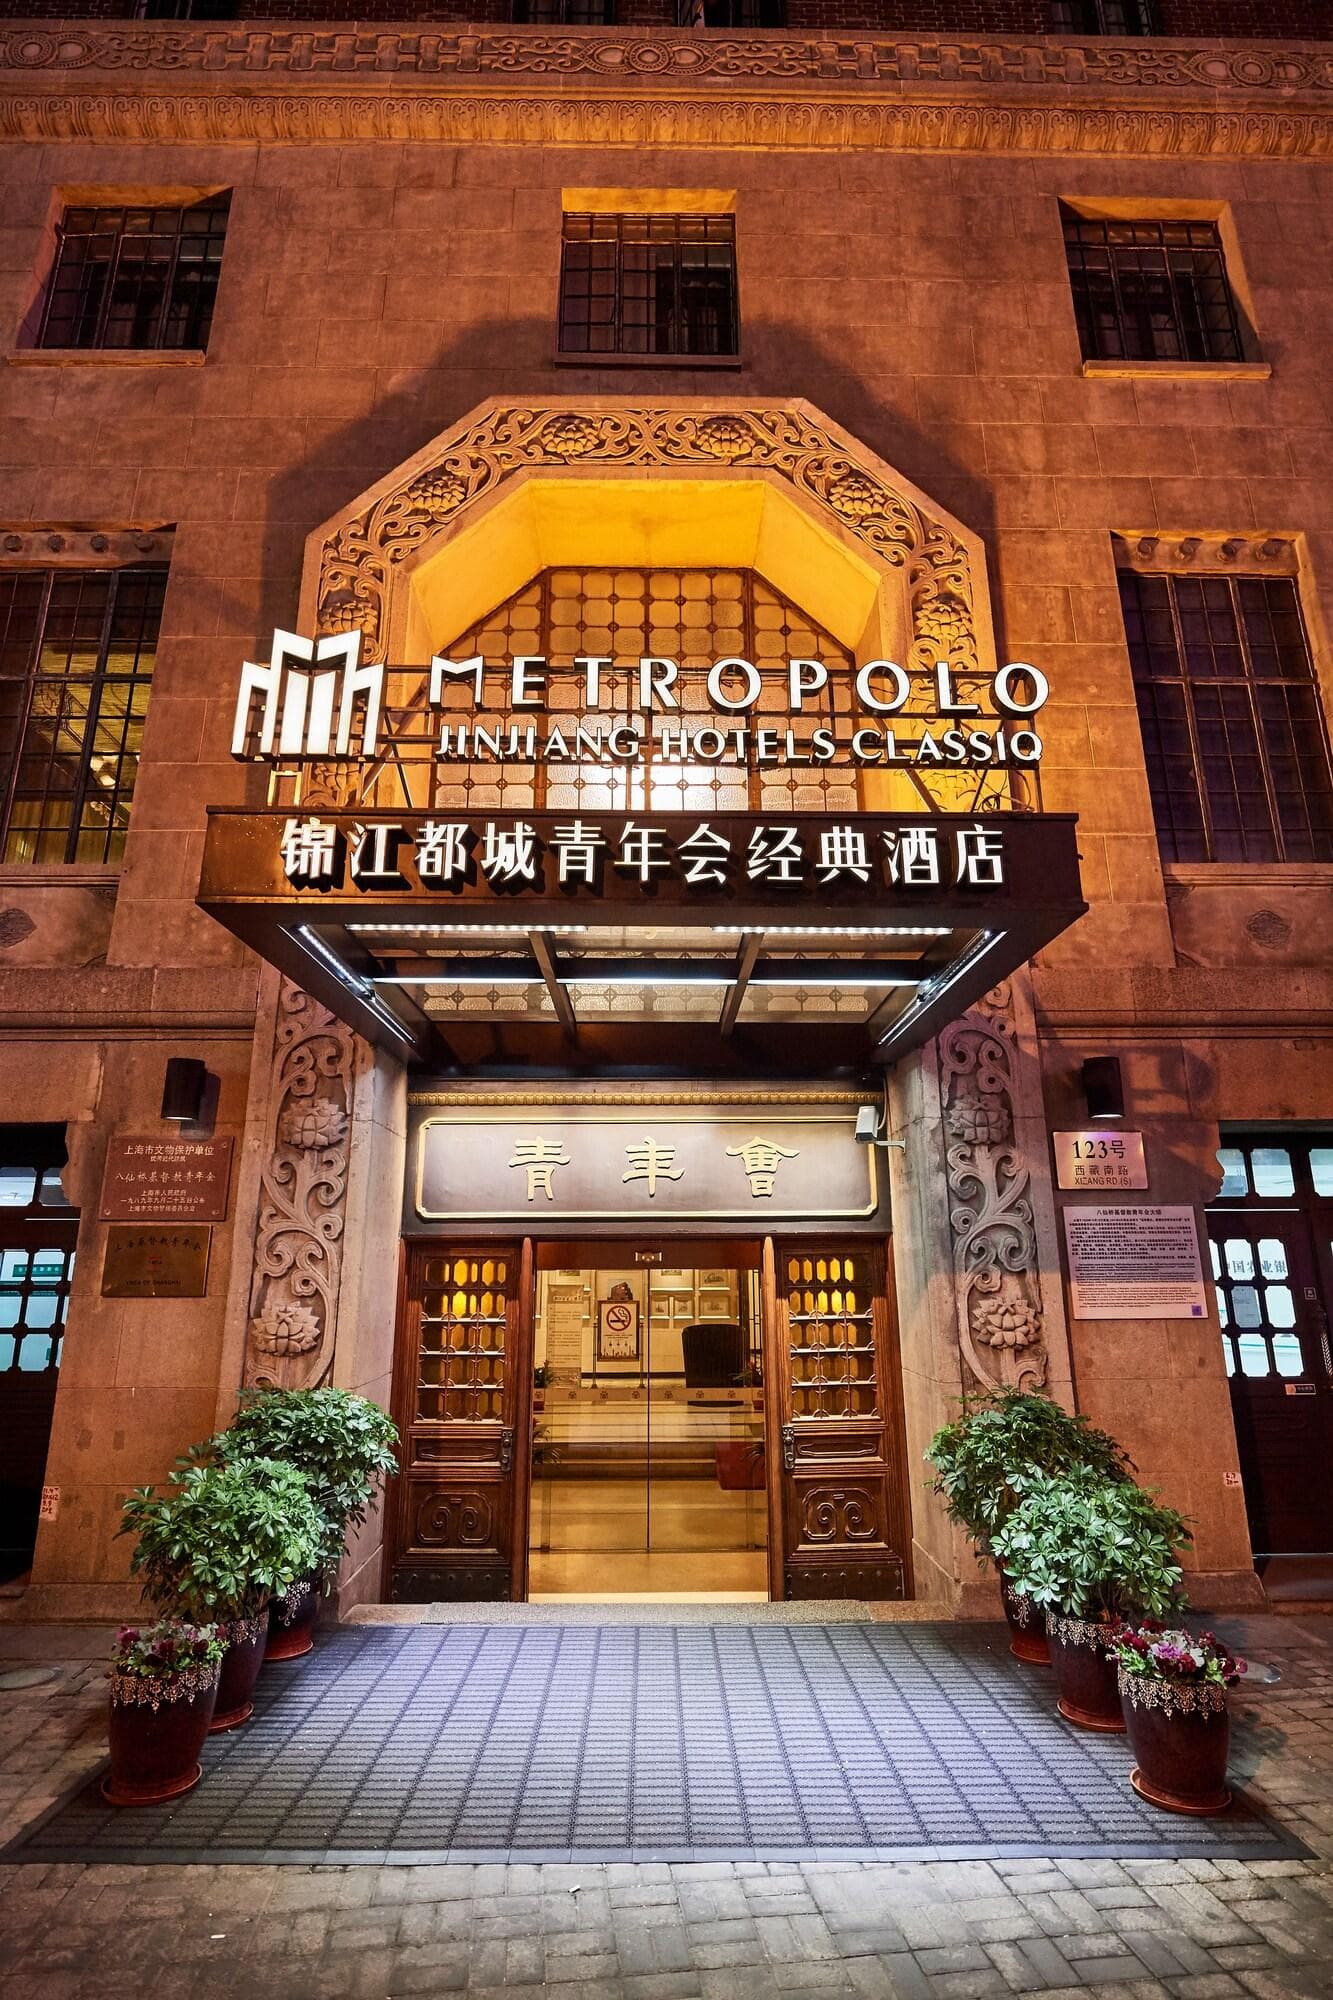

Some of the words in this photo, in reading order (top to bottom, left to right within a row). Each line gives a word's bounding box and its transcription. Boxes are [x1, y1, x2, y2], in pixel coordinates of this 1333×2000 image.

[429, 655, 1050, 714] METROPOLO
[435, 724, 641, 758] JINJIANG
[660, 726, 838, 760] HOTELS
[851, 728, 1043, 762] CLASSIQ
[280, 817, 1004, 885] 锦江都城青年会经典酒店
[1072, 1140, 1126, 1159] 123号
[1074, 1164, 1128, 1176] 西藏南路
